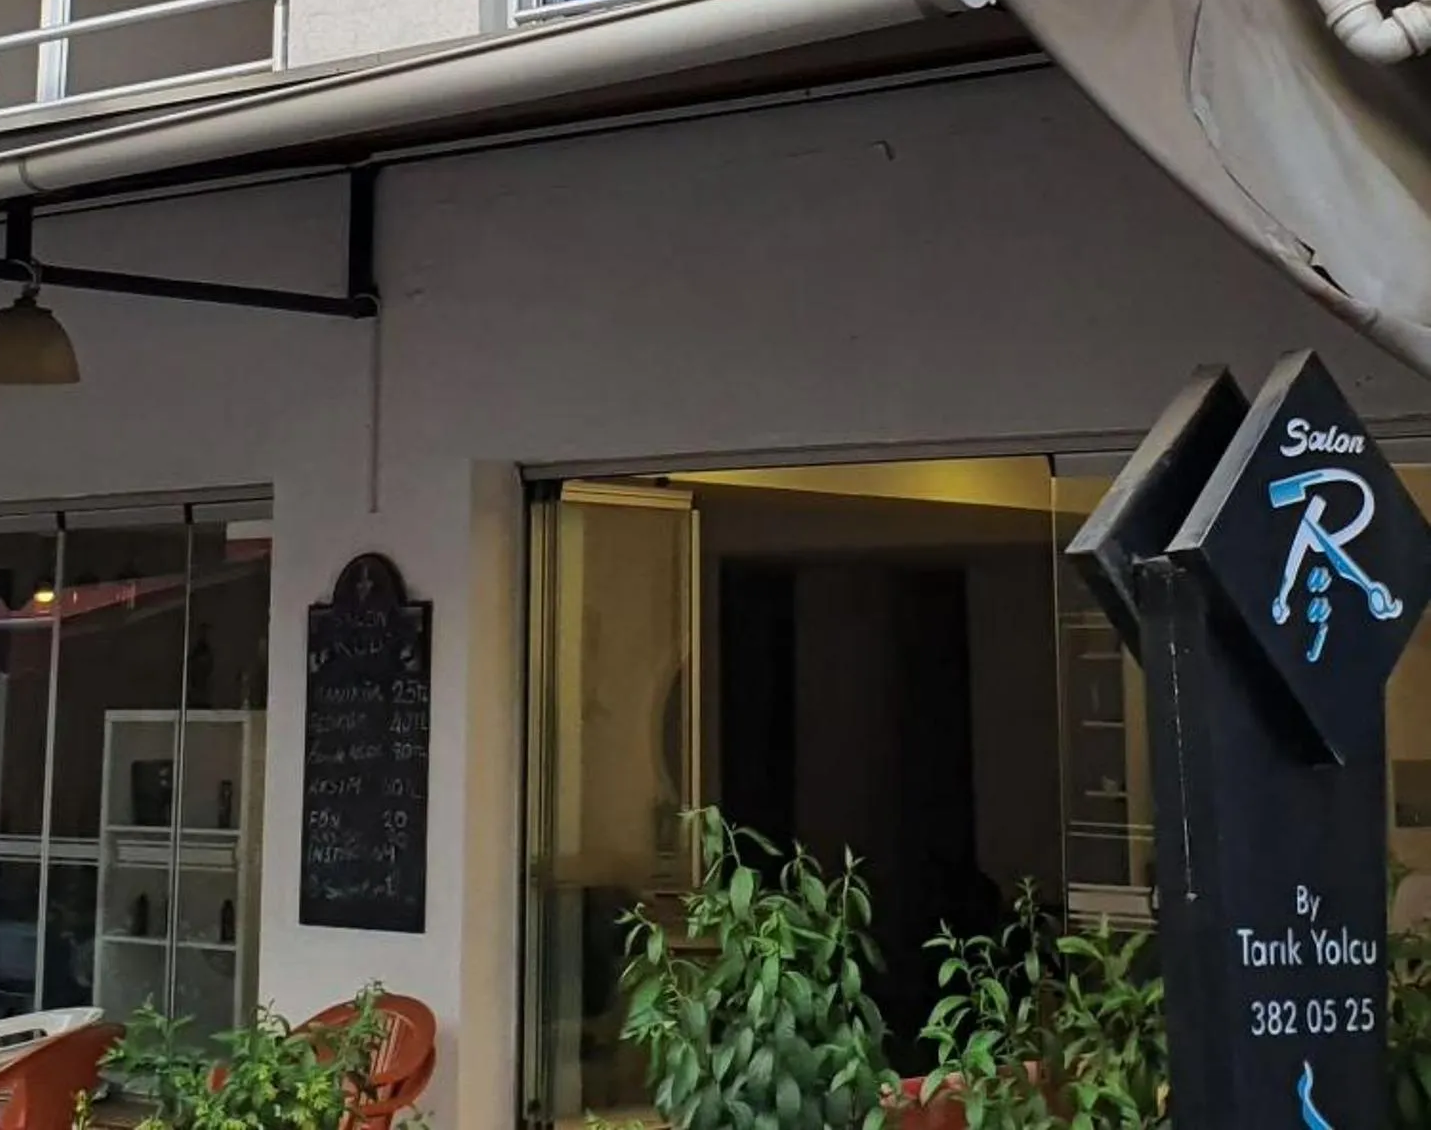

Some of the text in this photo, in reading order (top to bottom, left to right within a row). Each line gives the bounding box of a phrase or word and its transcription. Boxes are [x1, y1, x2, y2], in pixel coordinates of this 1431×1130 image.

[1279, 417, 1367, 458] Salon
[1296, 884, 1321, 923] By
[1310, 925, 1377, 966] Yolcu
[1250, 997, 1376, 1036] 382 05 25
